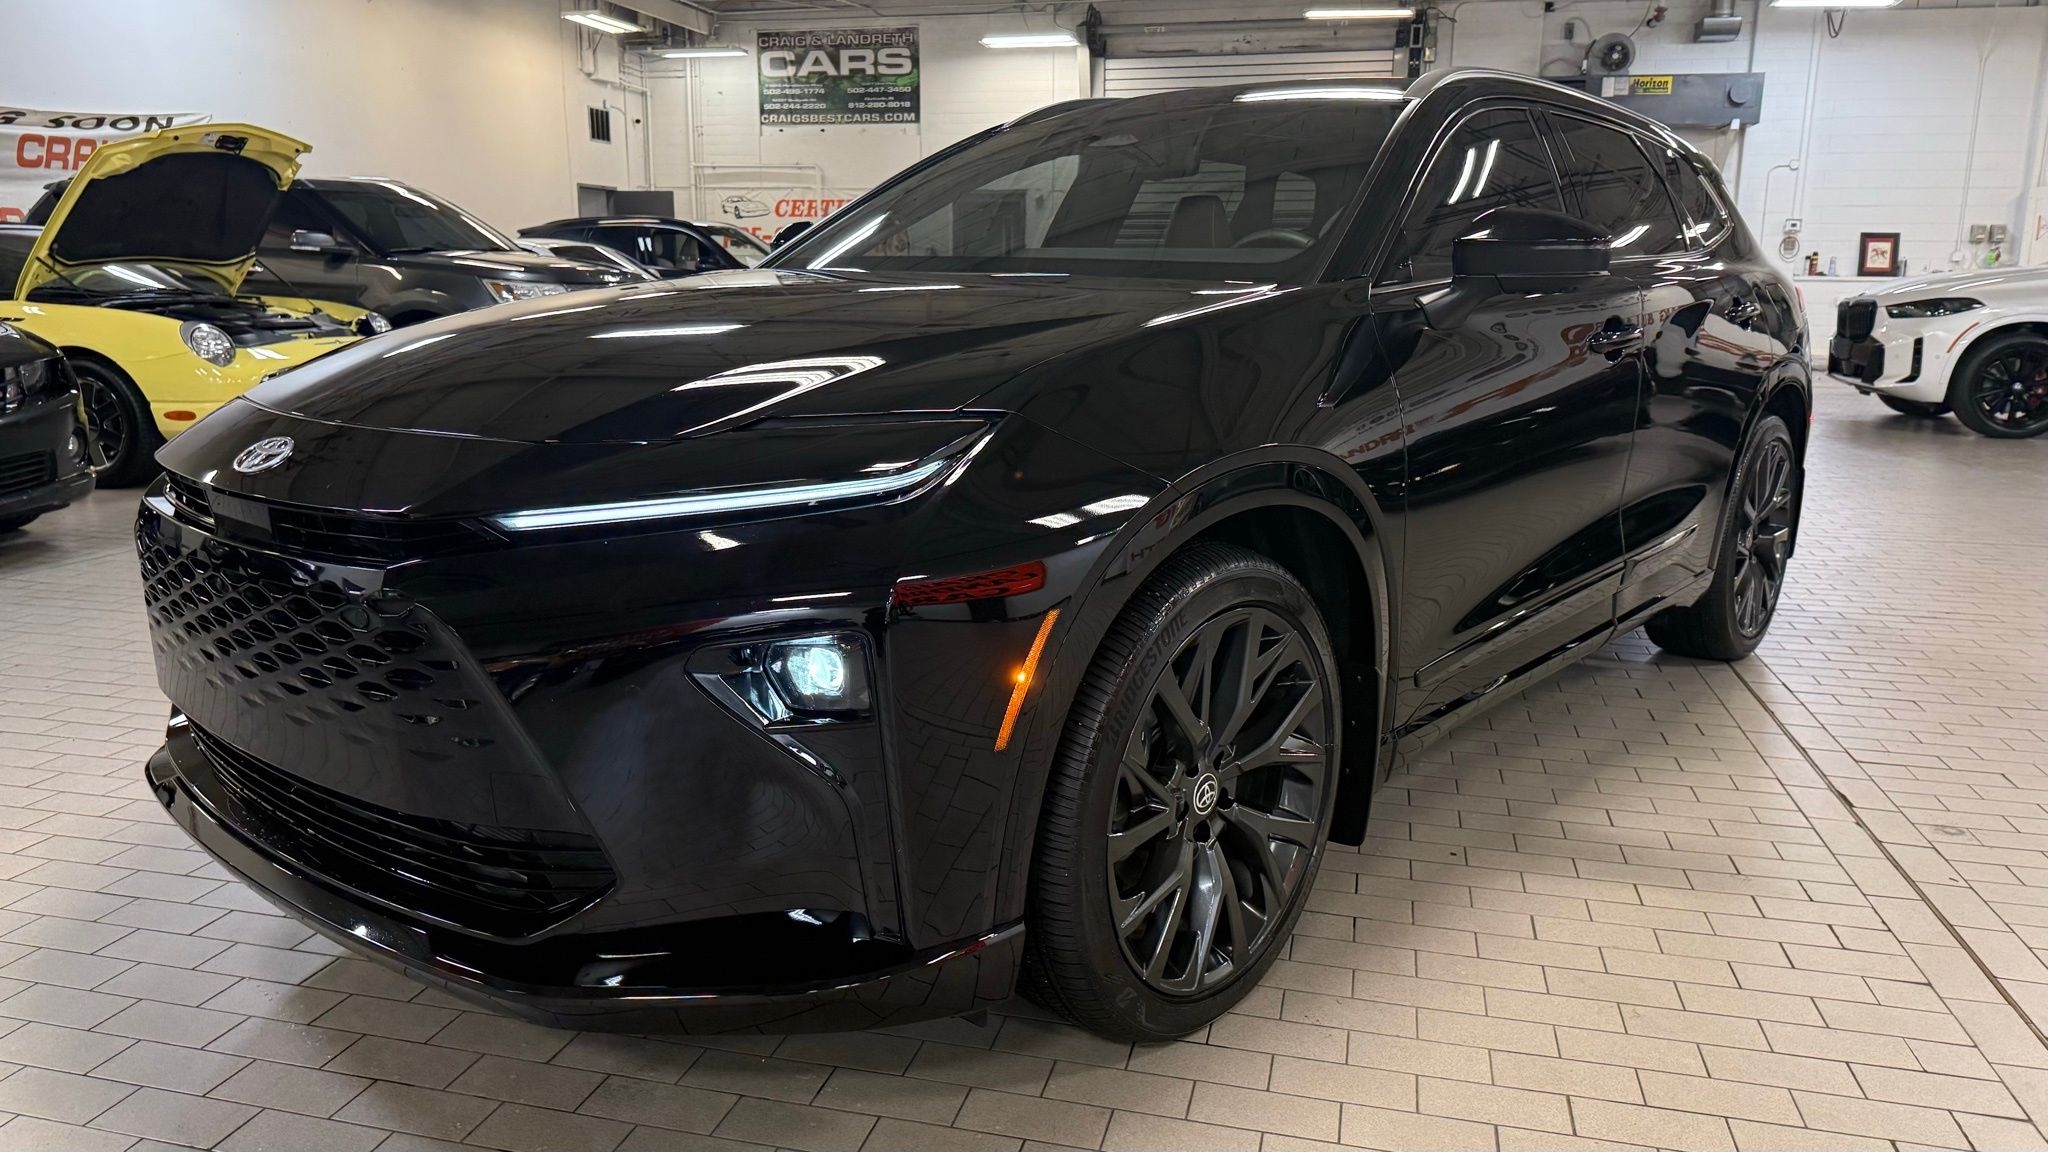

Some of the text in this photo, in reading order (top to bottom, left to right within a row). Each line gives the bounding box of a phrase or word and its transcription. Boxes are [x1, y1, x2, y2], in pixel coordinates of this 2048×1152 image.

[758, 33, 913, 47] CRAIG & LANDRETH
[760, 48, 912, 77] CARS
[1632, 77, 1669, 88] Horizon
[847, 86, 911, 94] 502-447-3450
[43, 115, 174, 132] SOON
[761, 112, 915, 124] CRAIGSBESTCARS.COM
[16, 133, 108, 170] CRA
